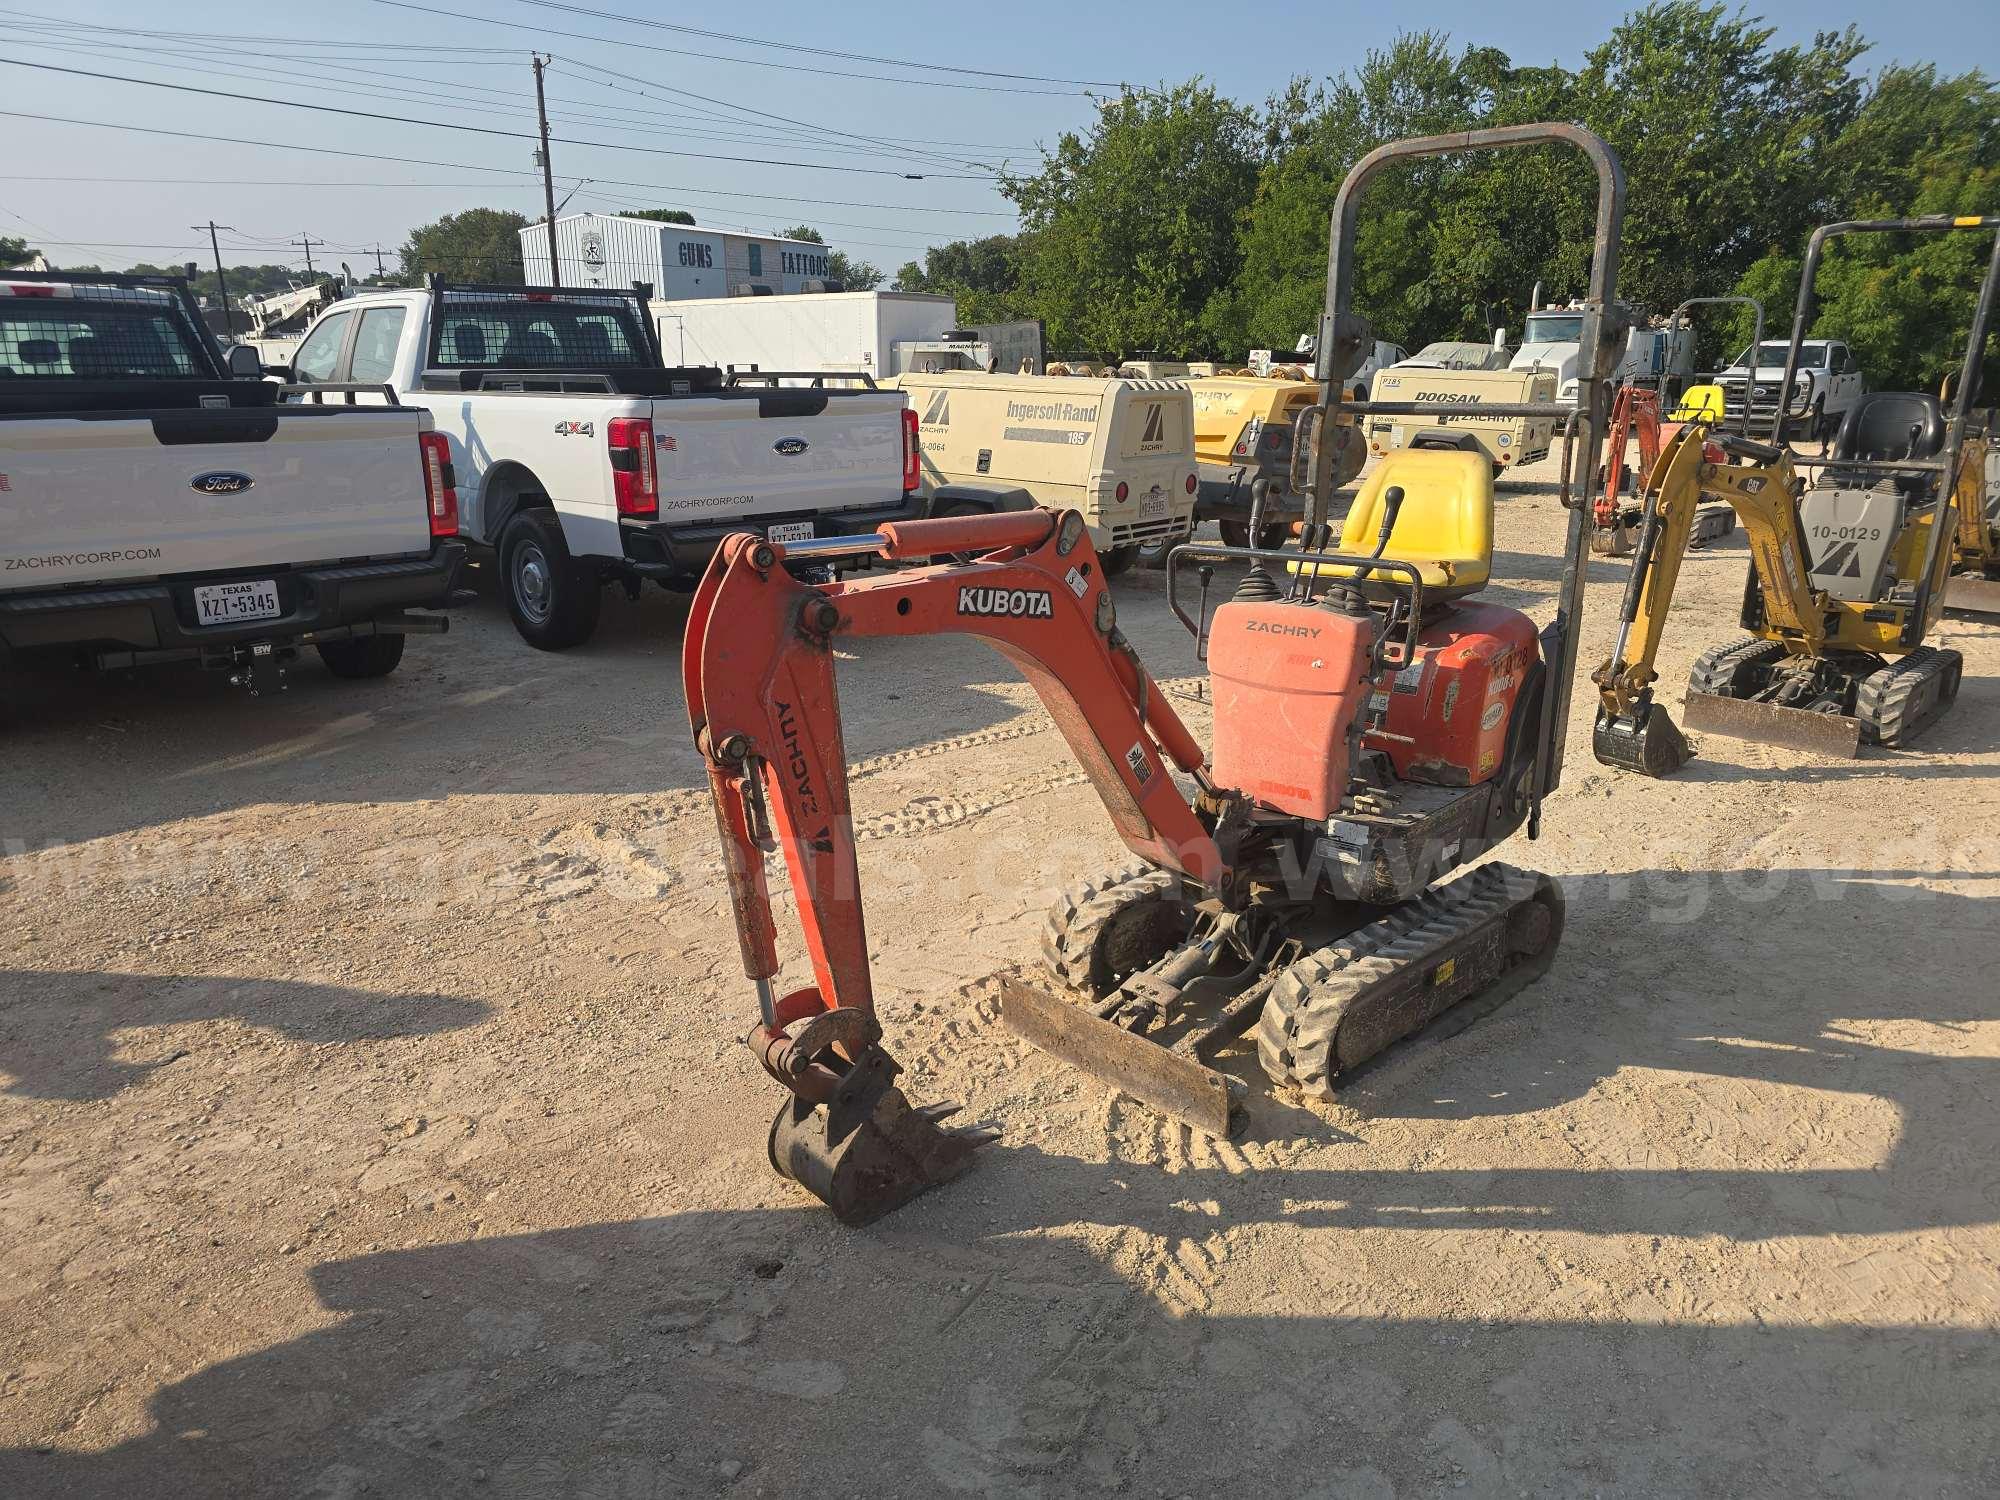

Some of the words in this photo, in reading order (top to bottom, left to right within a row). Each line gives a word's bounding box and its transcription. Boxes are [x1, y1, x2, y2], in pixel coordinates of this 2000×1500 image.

[679, 242, 713, 268] GUNS
[781, 251, 829, 277] TATTOOS
[1415, 391, 1480, 402] DOOSAN
[1007, 400, 1098, 422] Ingersoll-Rand
[920, 426, 949, 435] ZACHRY
[1067, 431, 1084, 445] 185
[666, 495, 754, 510] ZACHRYCORP.COM
[1811, 525, 1881, 541] 10-0129
[5, 548, 161, 570] ZACHRYCORP.COM
[221, 585, 253, 595] TEXAS
[958, 587, 1052, 616] KUBOTA
[1246, 620, 1322, 639] ZACHRY
